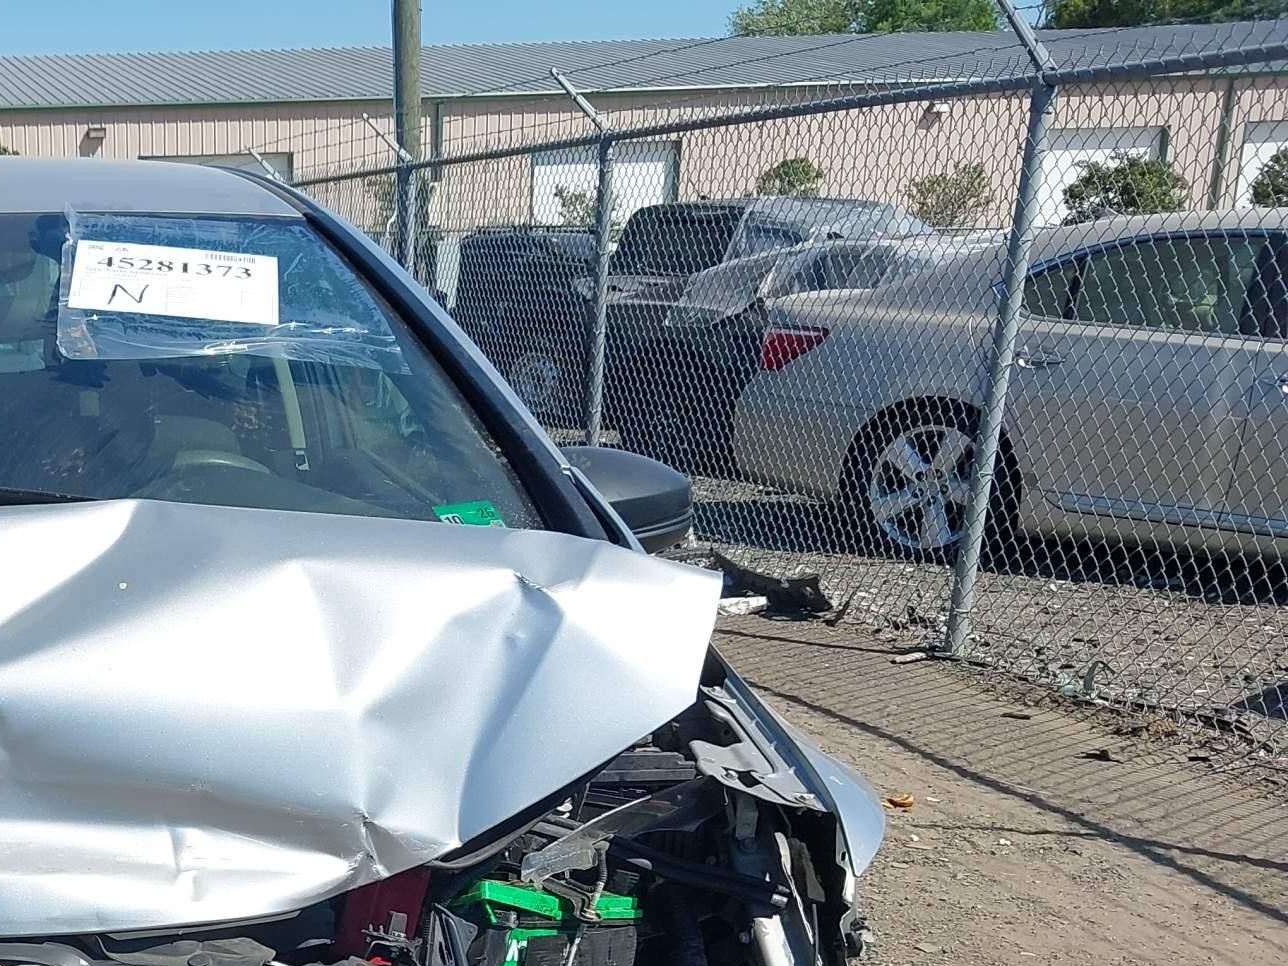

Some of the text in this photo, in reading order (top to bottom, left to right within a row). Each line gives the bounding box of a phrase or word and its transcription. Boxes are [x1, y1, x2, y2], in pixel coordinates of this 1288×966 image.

[97, 256, 252, 280] 45281373
[108, 283, 150, 305] N
[476, 507, 496, 519] 26
